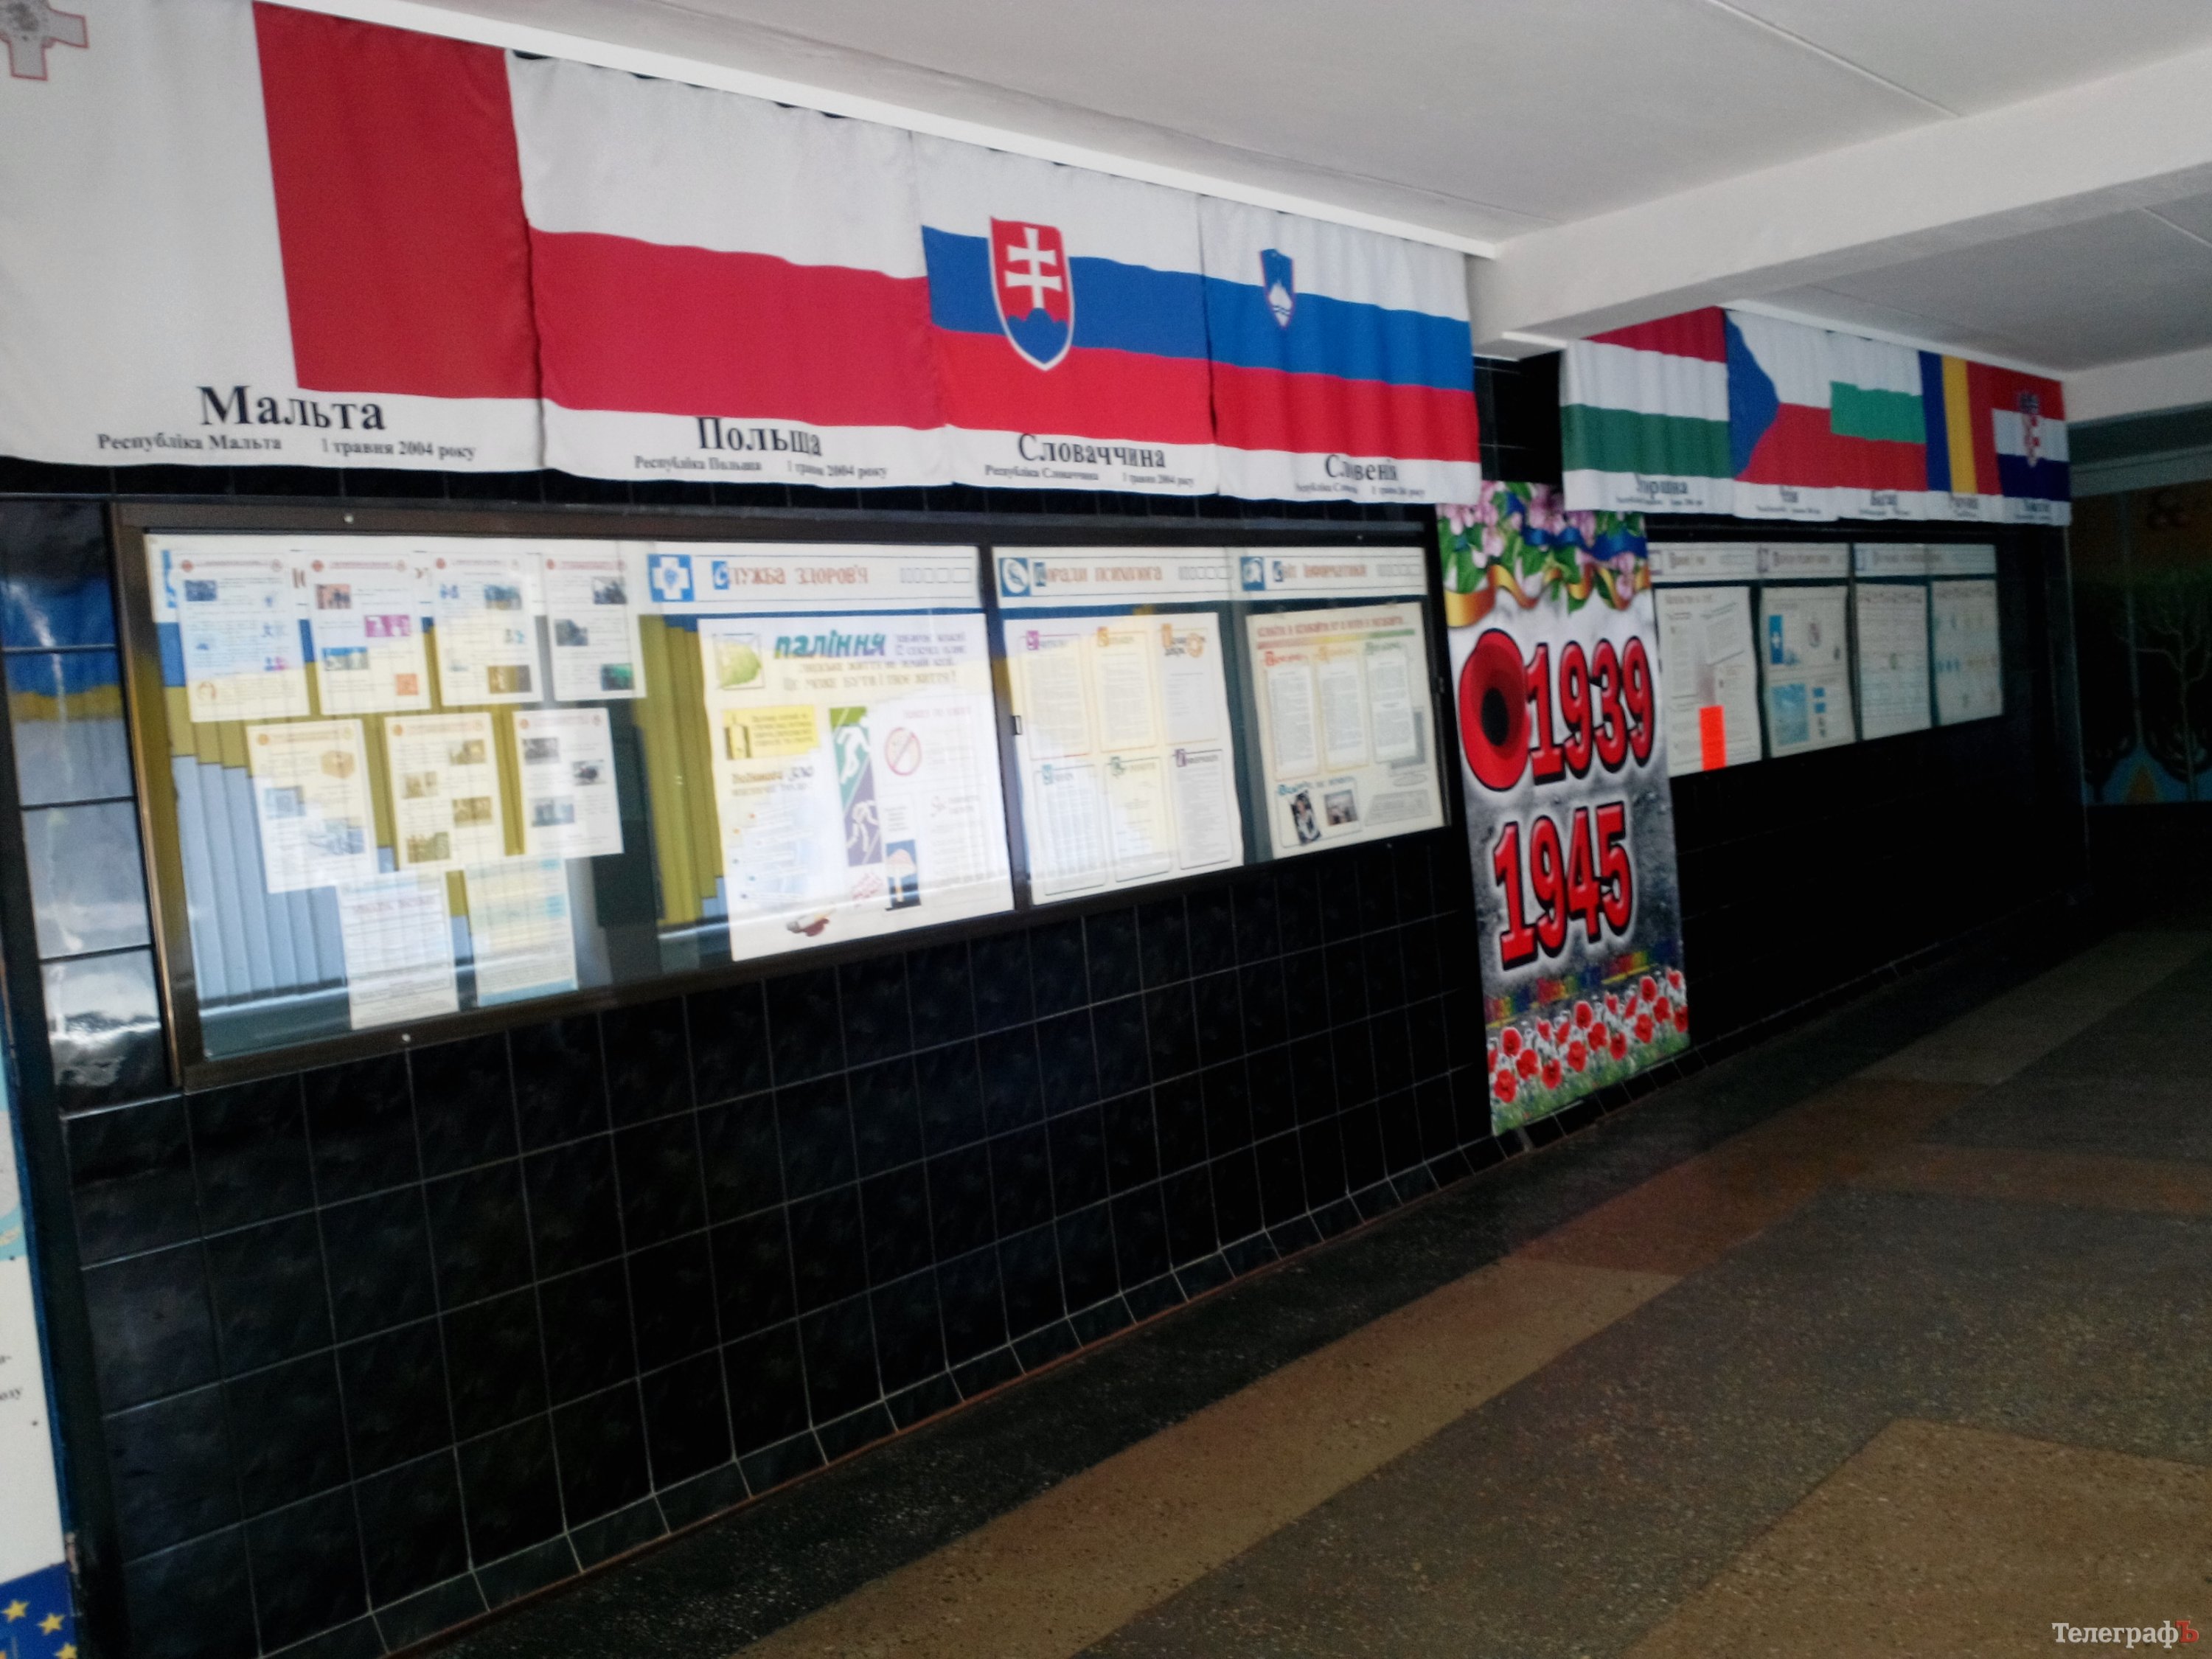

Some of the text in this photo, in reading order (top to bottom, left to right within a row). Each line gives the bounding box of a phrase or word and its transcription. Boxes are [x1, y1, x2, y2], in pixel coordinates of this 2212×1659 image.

[196, 385, 386, 430] Мальта
[97, 432, 203, 451] Республіка
[209, 434, 282, 450] Мальта
[333, 442, 394, 456] травня
[399, 440, 434, 455] 2004
[438, 445, 476, 462] року
[1019, 433, 1166, 468] Словаччина
[1526, 636, 1655, 785] 1939
[1493, 801, 1632, 970] 1945
